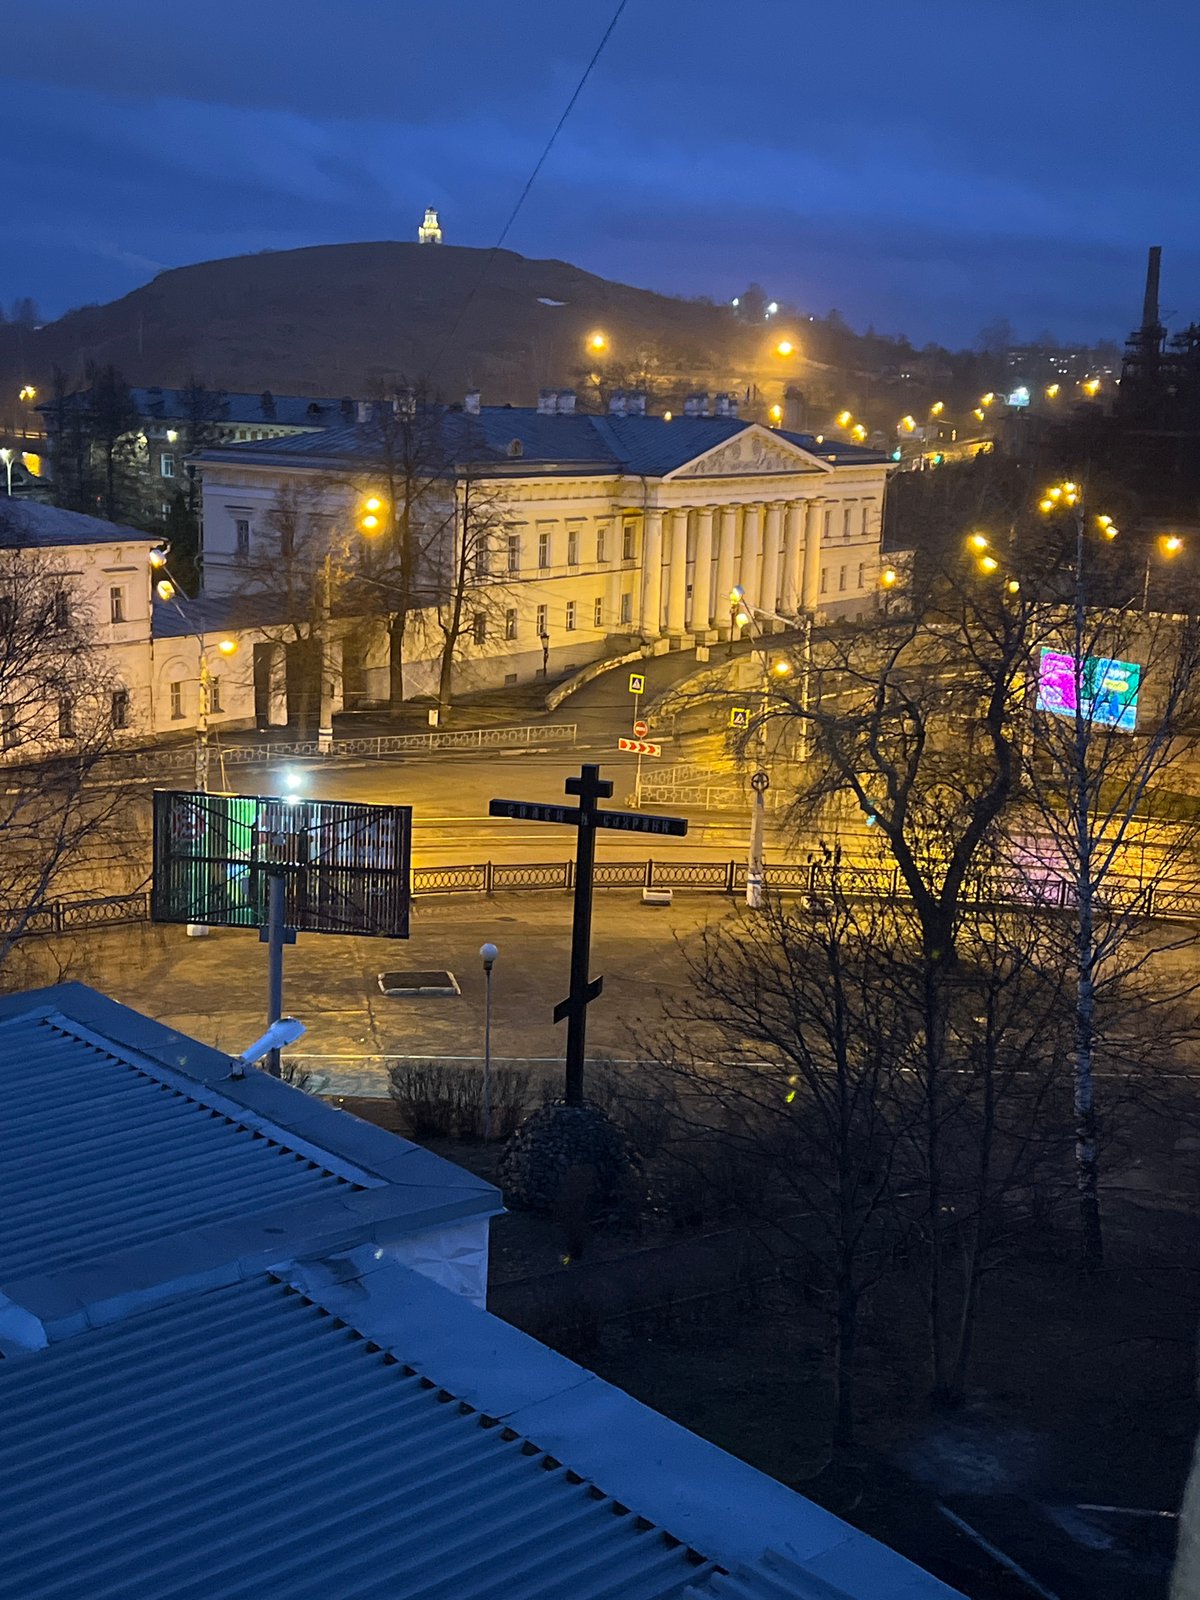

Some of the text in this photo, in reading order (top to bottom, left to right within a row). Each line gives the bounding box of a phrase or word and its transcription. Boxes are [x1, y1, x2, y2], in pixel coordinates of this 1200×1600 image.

[507, 803, 671, 834] СПАСИ И СОХРАНИ
